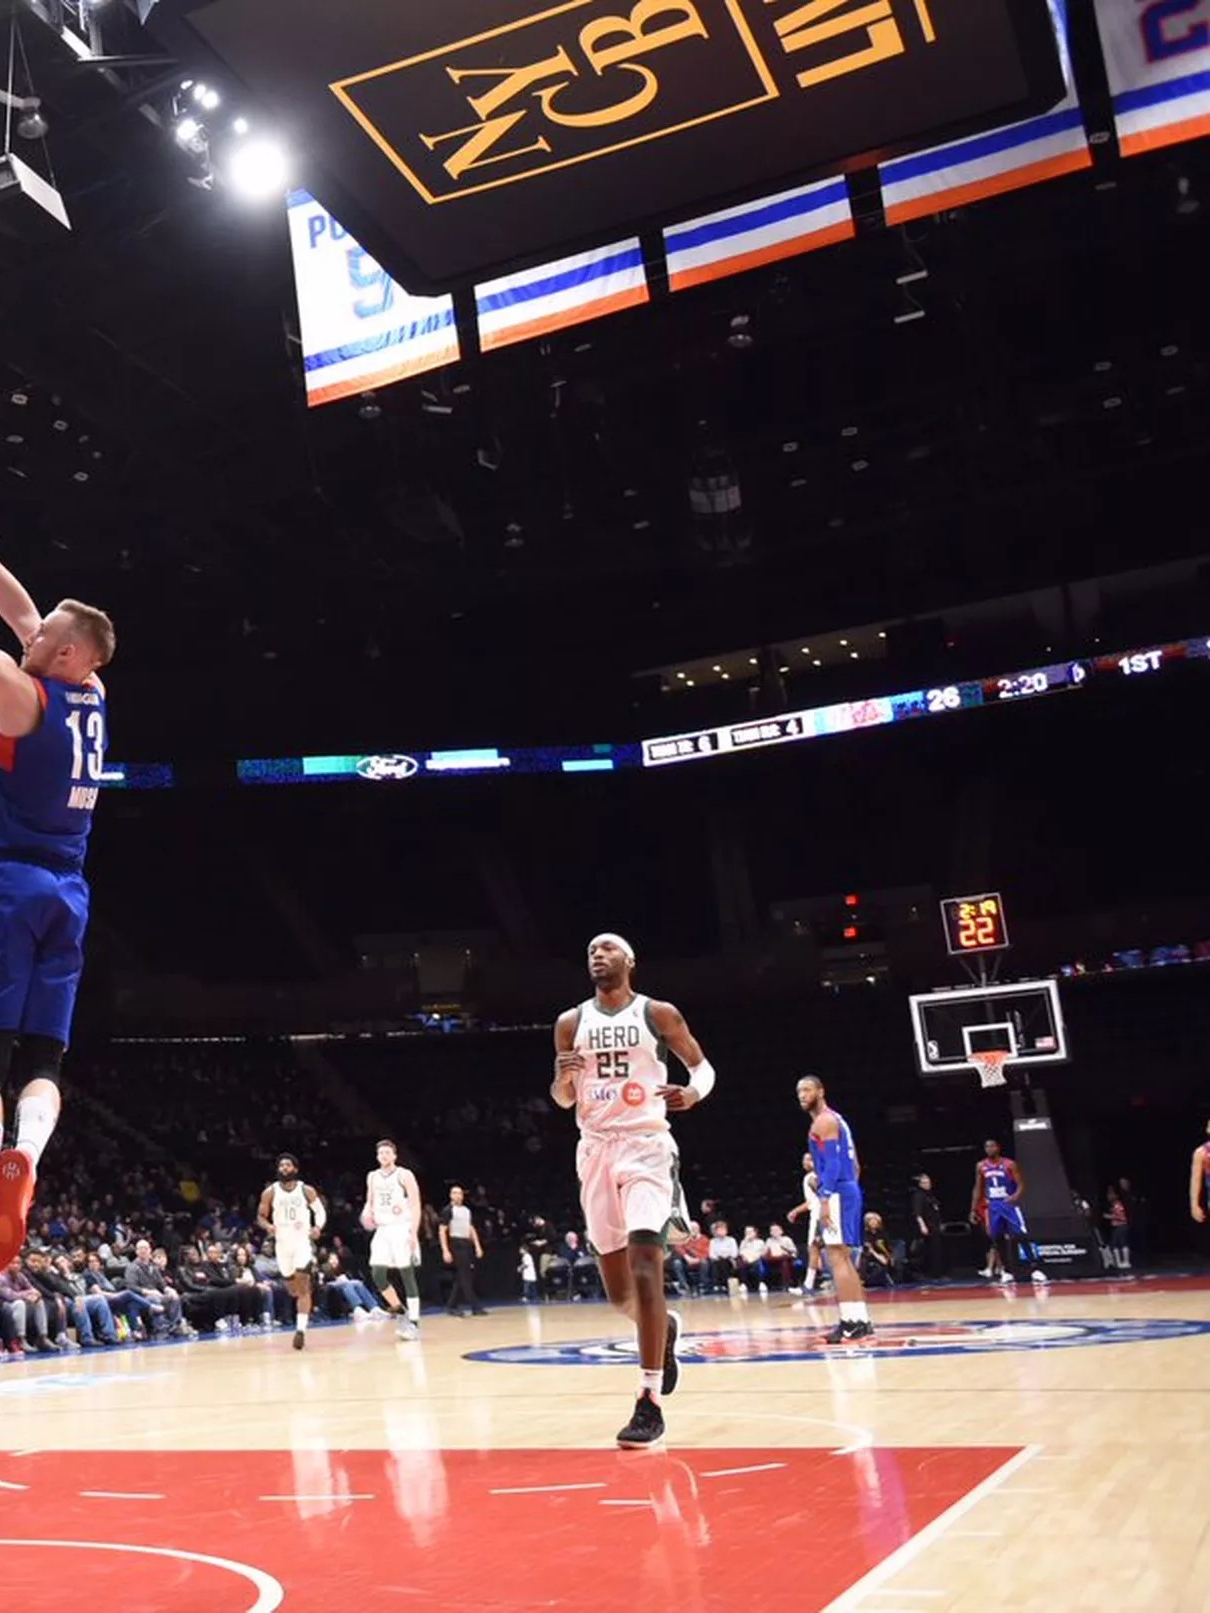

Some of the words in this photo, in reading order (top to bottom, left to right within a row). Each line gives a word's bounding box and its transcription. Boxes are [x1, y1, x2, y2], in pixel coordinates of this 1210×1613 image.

[1117, 649, 1164, 675] 1ST
[925, 685, 962, 713] 26
[996, 672, 1049, 699] 2:20
[65, 710, 103, 780] 13
[958, 917, 995, 947] 22
[588, 1025, 640, 1049] HERD
[595, 1050, 629, 1079] 25
